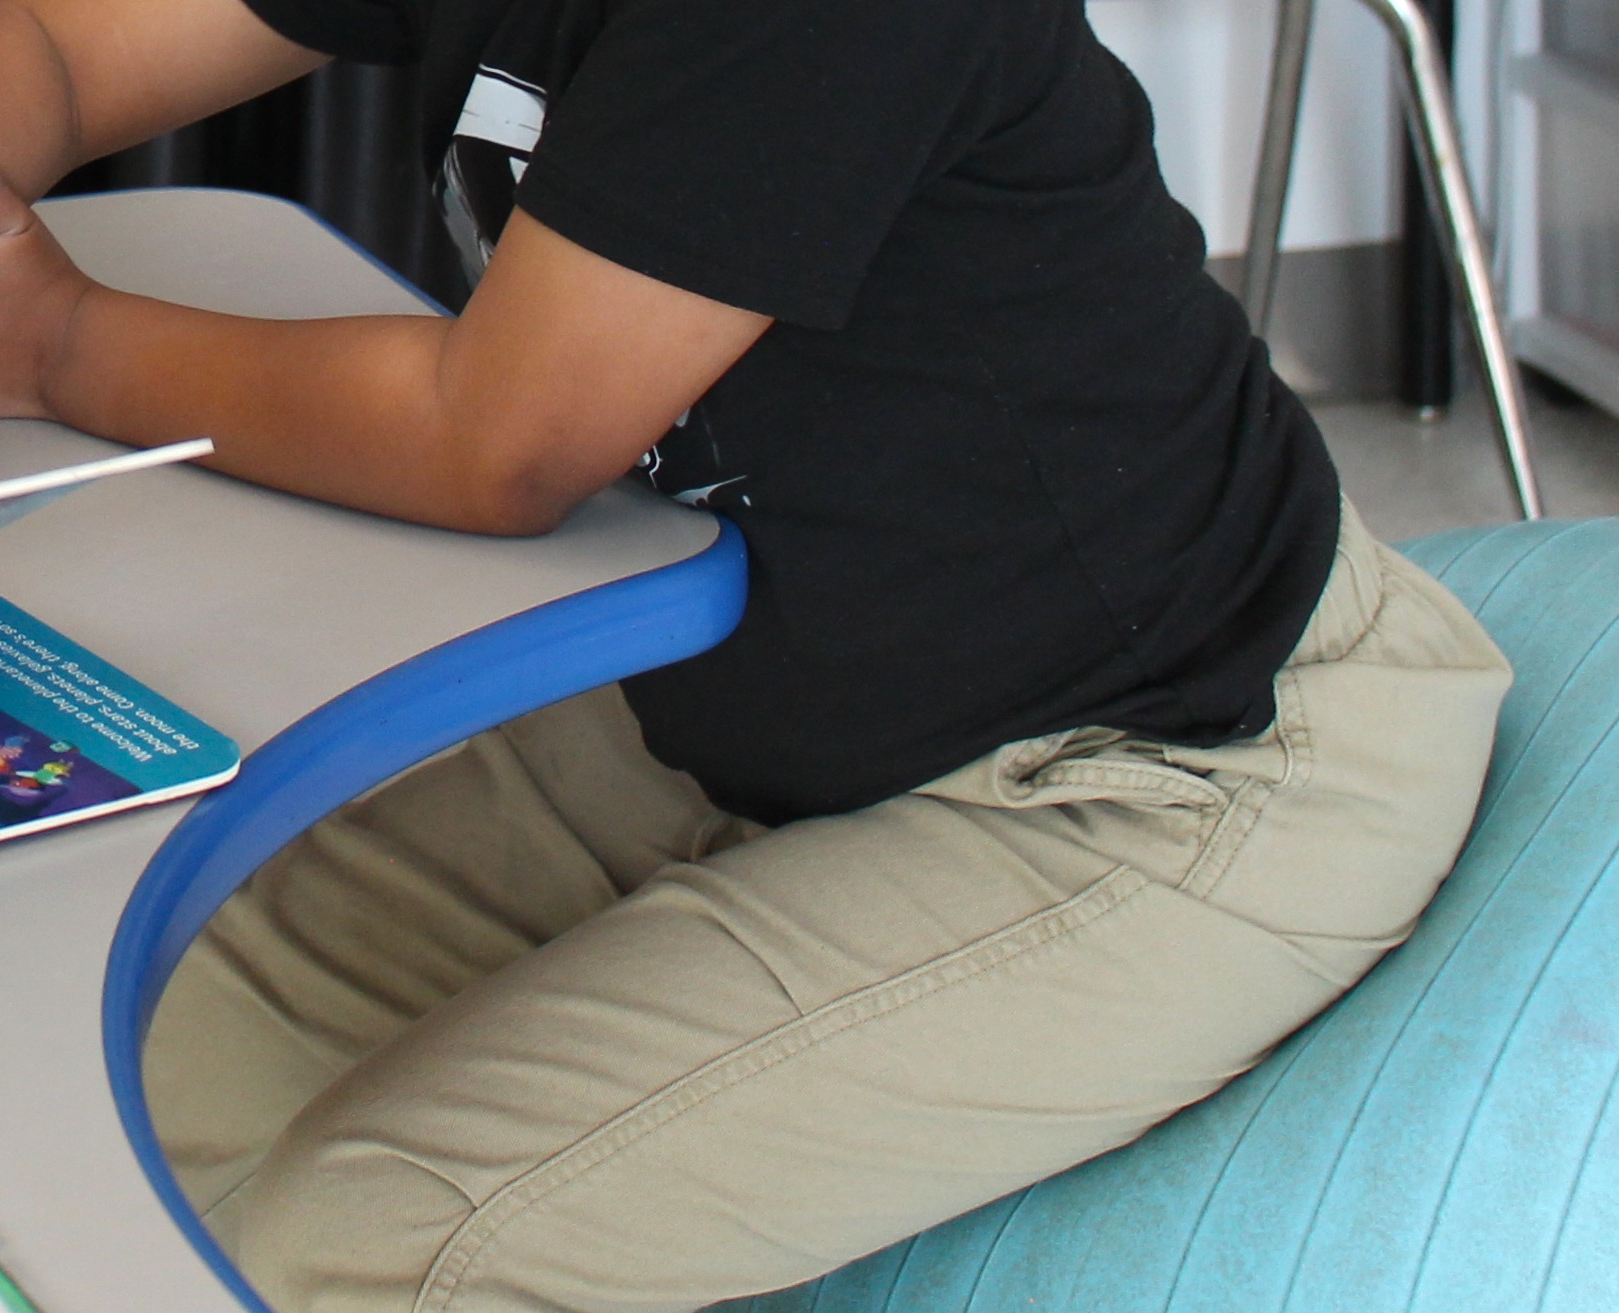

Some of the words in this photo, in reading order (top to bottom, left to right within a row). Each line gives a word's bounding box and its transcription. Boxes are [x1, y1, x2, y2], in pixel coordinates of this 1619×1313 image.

[14, 633, 60, 662] there's
[53, 697, 79, 713] the
[96, 684, 134, 709] Come
[76, 712, 95, 723] to
[135, 707, 176, 734] moon.
[91, 722, 152, 762] Welcome
[133, 729, 177, 755] about
[172, 733, 199, 750] the
